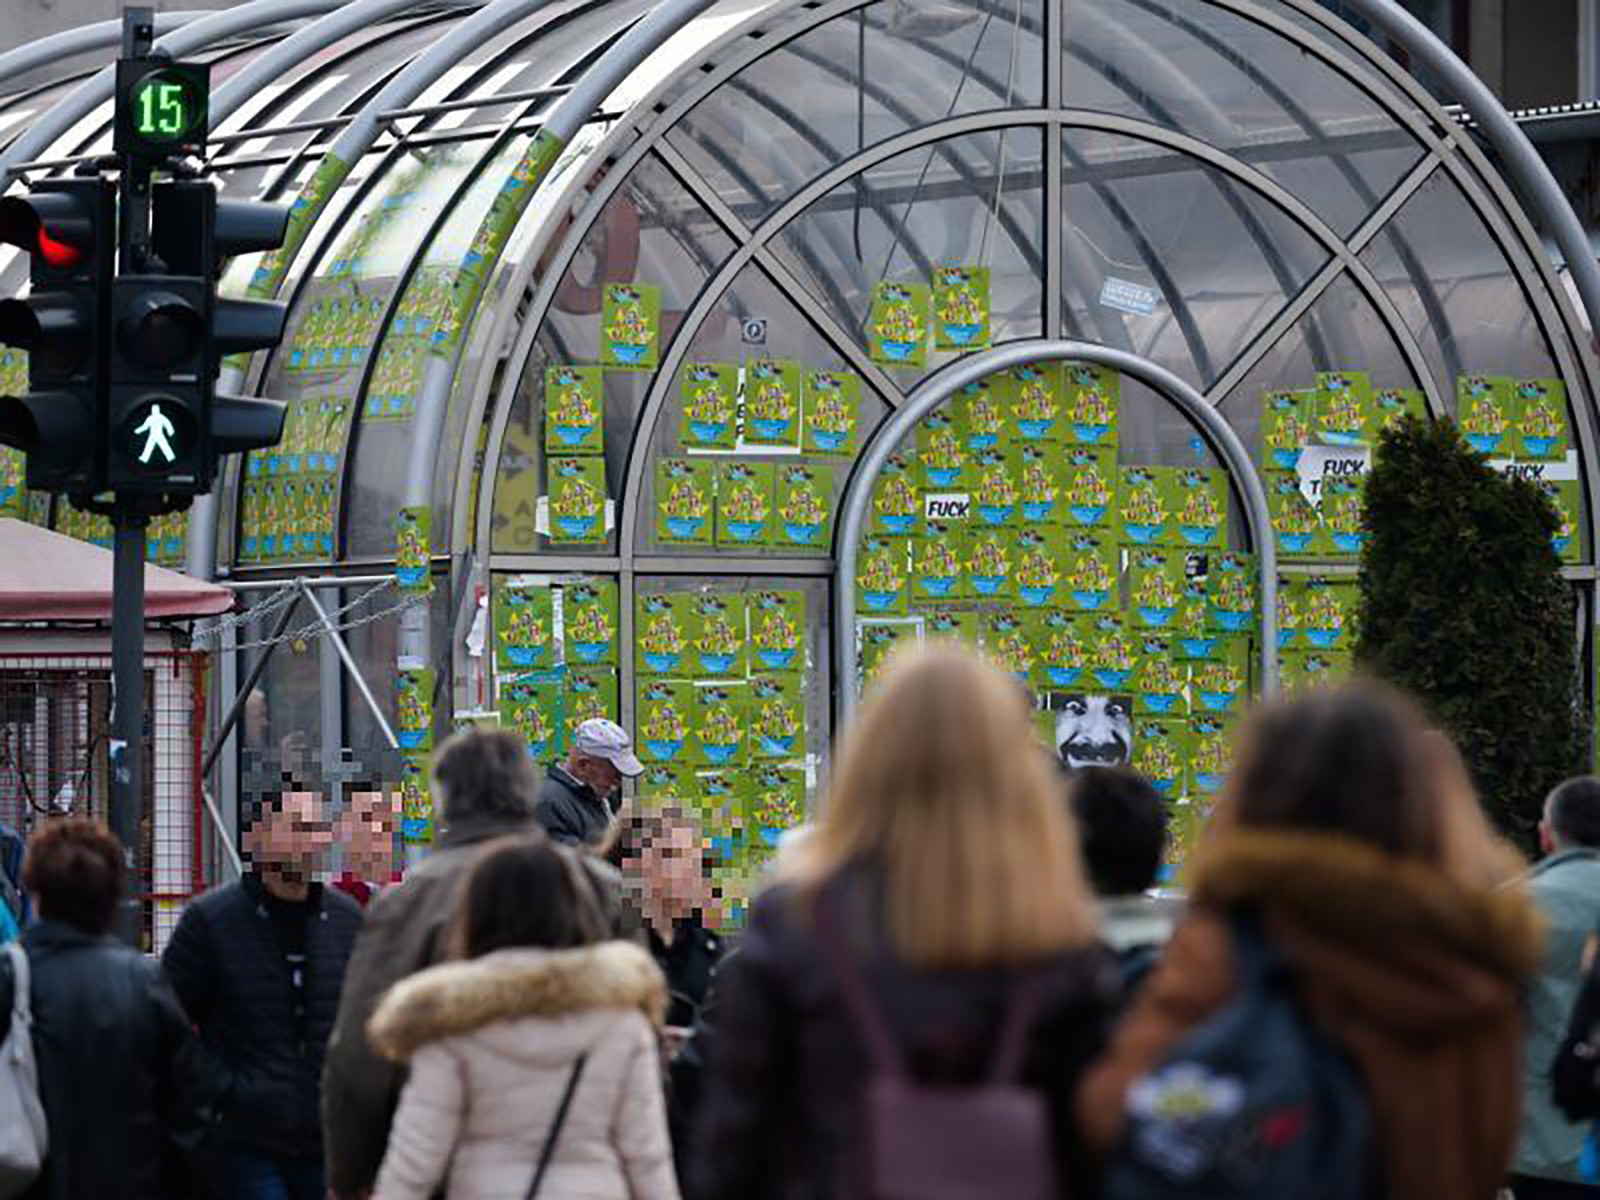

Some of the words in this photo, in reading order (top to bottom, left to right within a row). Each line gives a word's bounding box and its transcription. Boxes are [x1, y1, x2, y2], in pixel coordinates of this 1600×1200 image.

[139, 84, 182, 132] 15
[1323, 459, 1365, 475] FUCK
[927, 500, 969, 517] FUCK
